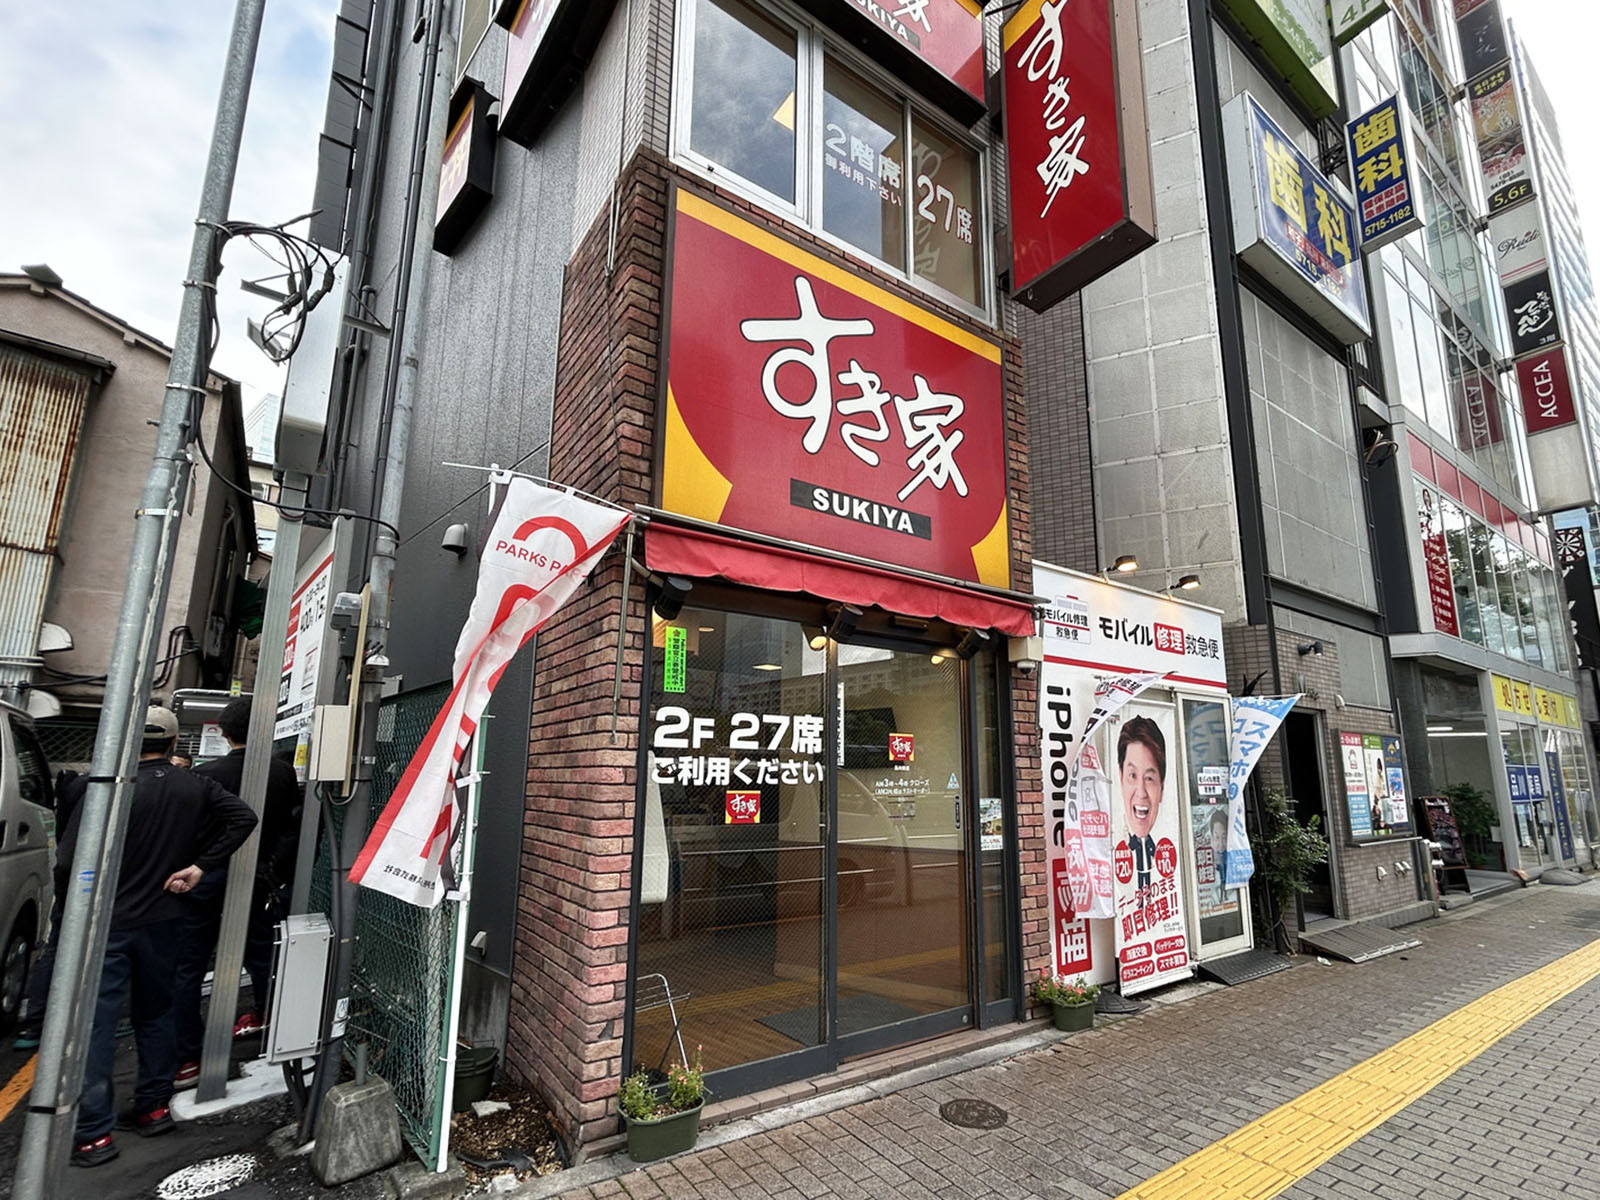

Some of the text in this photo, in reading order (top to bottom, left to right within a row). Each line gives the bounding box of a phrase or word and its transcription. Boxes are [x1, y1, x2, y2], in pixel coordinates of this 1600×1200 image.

[1353, 106, 1404, 194] 歯科
[825, 123, 902, 189] 2階席
[917, 174, 973, 244] 27席
[1263, 129, 1353, 277] 歯科
[1364, 206, 1412, 236] 5715-1182
[740, 275, 969, 502] すき家
[1532, 360, 1559, 418] ACCEA
[812, 488, 915, 534] SUKIYA
[495, 539, 547, 569] PARKS
[1098, 616, 1220, 661] モバイル修理救急便
[653, 706, 716, 749] 2F
[729, 712, 824, 754] 27席
[651, 755, 824, 786] ご利用ください
